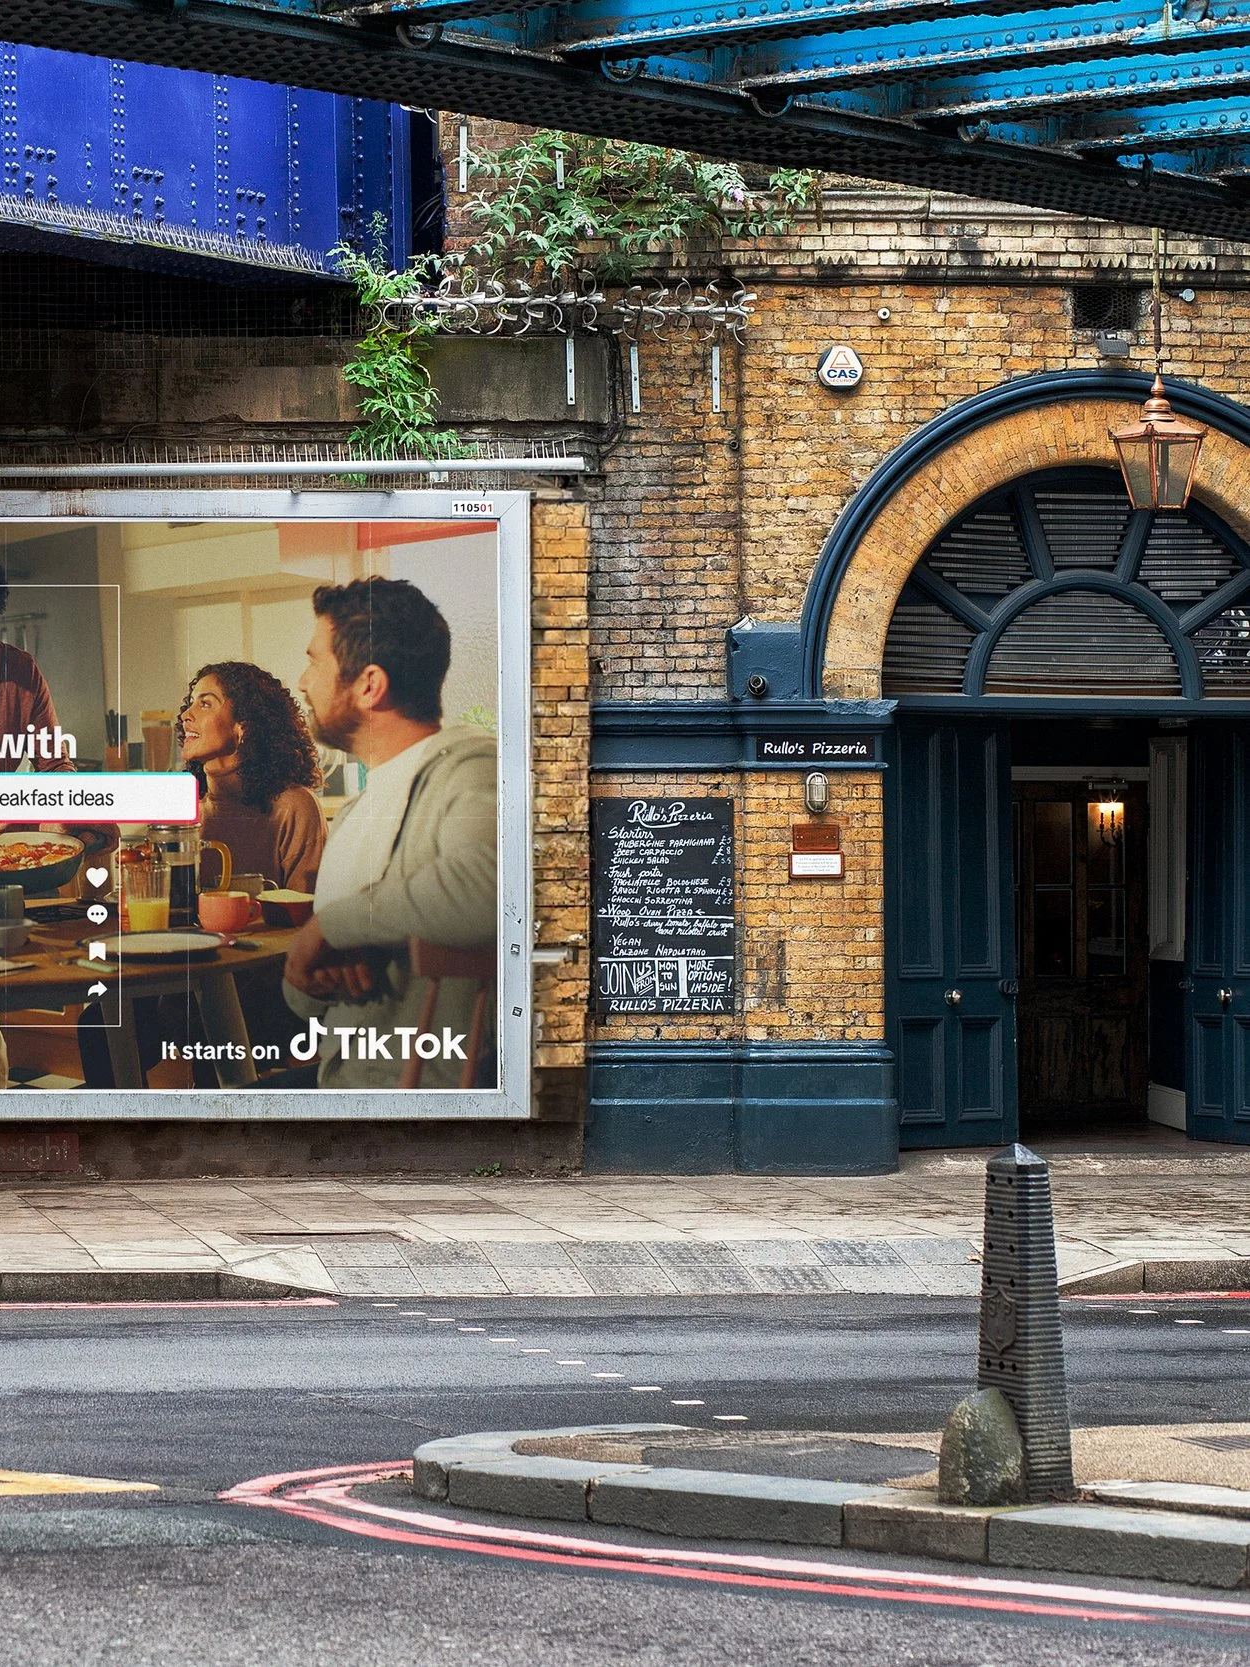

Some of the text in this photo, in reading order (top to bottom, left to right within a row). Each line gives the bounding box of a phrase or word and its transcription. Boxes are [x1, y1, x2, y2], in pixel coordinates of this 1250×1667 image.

[827, 369, 859, 379] CAS
[453, 503, 493, 512] 110501
[764, 741, 868, 755] Rullo's Pizzeria
[68, 789, 114, 807] ideas
[627, 800, 714, 828] Rullo's Pizzeria
[639, 848, 683, 856] CARPACCIO
[646, 857, 670, 865] SALAD
[646, 886, 681, 895] RICOTTA
[684, 886, 692, 894] &
[644, 895, 693, 905] SORRENTINA
[666, 904, 693, 917] PIZZA
[611, 916, 640, 927] Rullo's
[612, 932, 641, 946] VEGAN
[637, 961, 652, 976] US
[659, 961, 678, 971] MON
[687, 960, 715, 971] MORE
[599, 961, 637, 995] JOIN
[661, 971, 673, 980] TO
[688, 970, 727, 981] OPTIONS
[659, 982, 678, 991] SUN
[609, 998, 657, 1011] RULLO'S
[161, 1026, 468, 1061] It starts on TikTok
